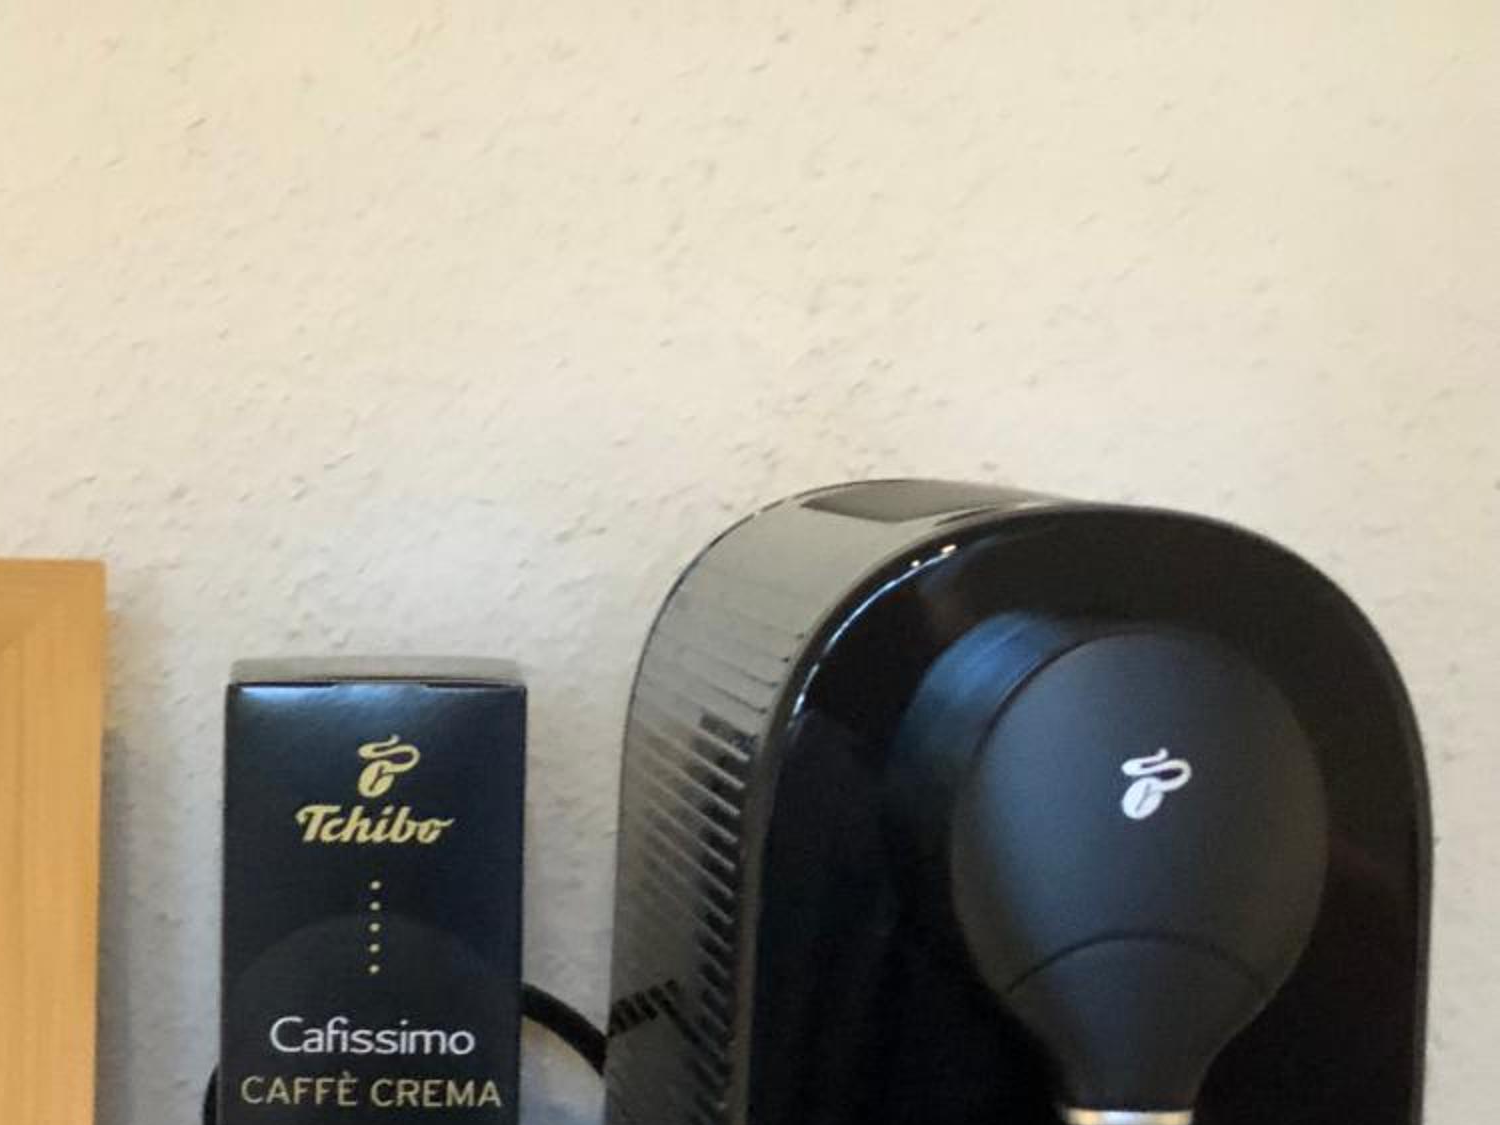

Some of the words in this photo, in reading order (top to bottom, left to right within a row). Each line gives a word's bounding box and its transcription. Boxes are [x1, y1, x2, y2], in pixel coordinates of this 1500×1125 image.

[295, 803, 454, 845] Tchibo
[269, 1015, 476, 1055] Cafissimo
[240, 1071, 358, 1105] CAFFÈ
[370, 1077, 503, 1108] CREMA
